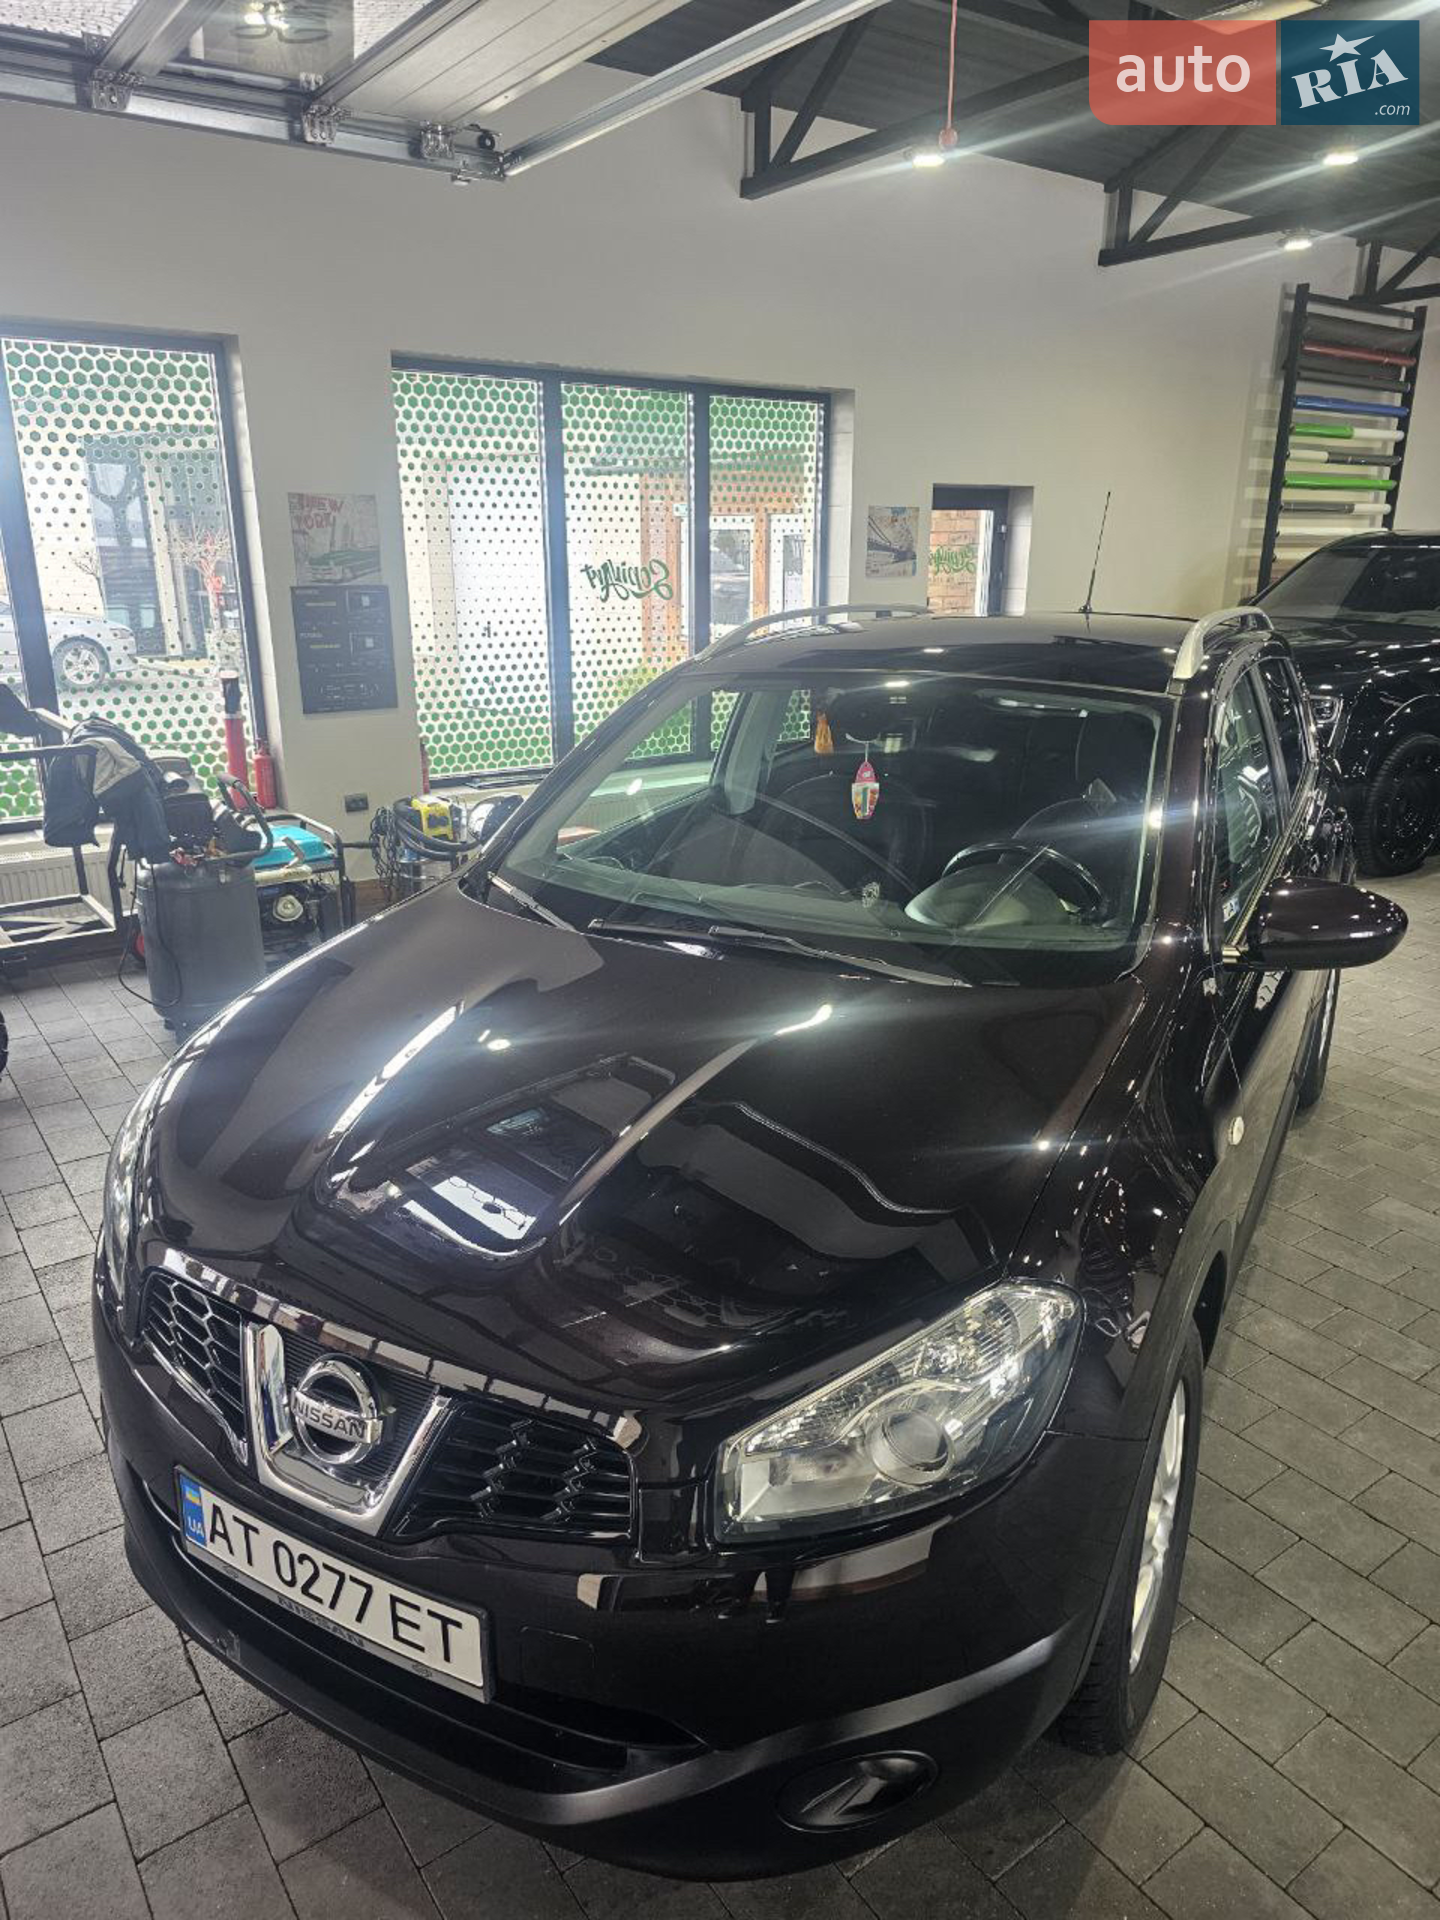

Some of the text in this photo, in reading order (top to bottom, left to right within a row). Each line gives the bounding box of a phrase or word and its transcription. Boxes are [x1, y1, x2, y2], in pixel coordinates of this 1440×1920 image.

[293, 1397, 368, 1439] NISSAN
[187, 1515, 206, 1538] UA
[208, 1502, 463, 1663] AT 0277 ET
